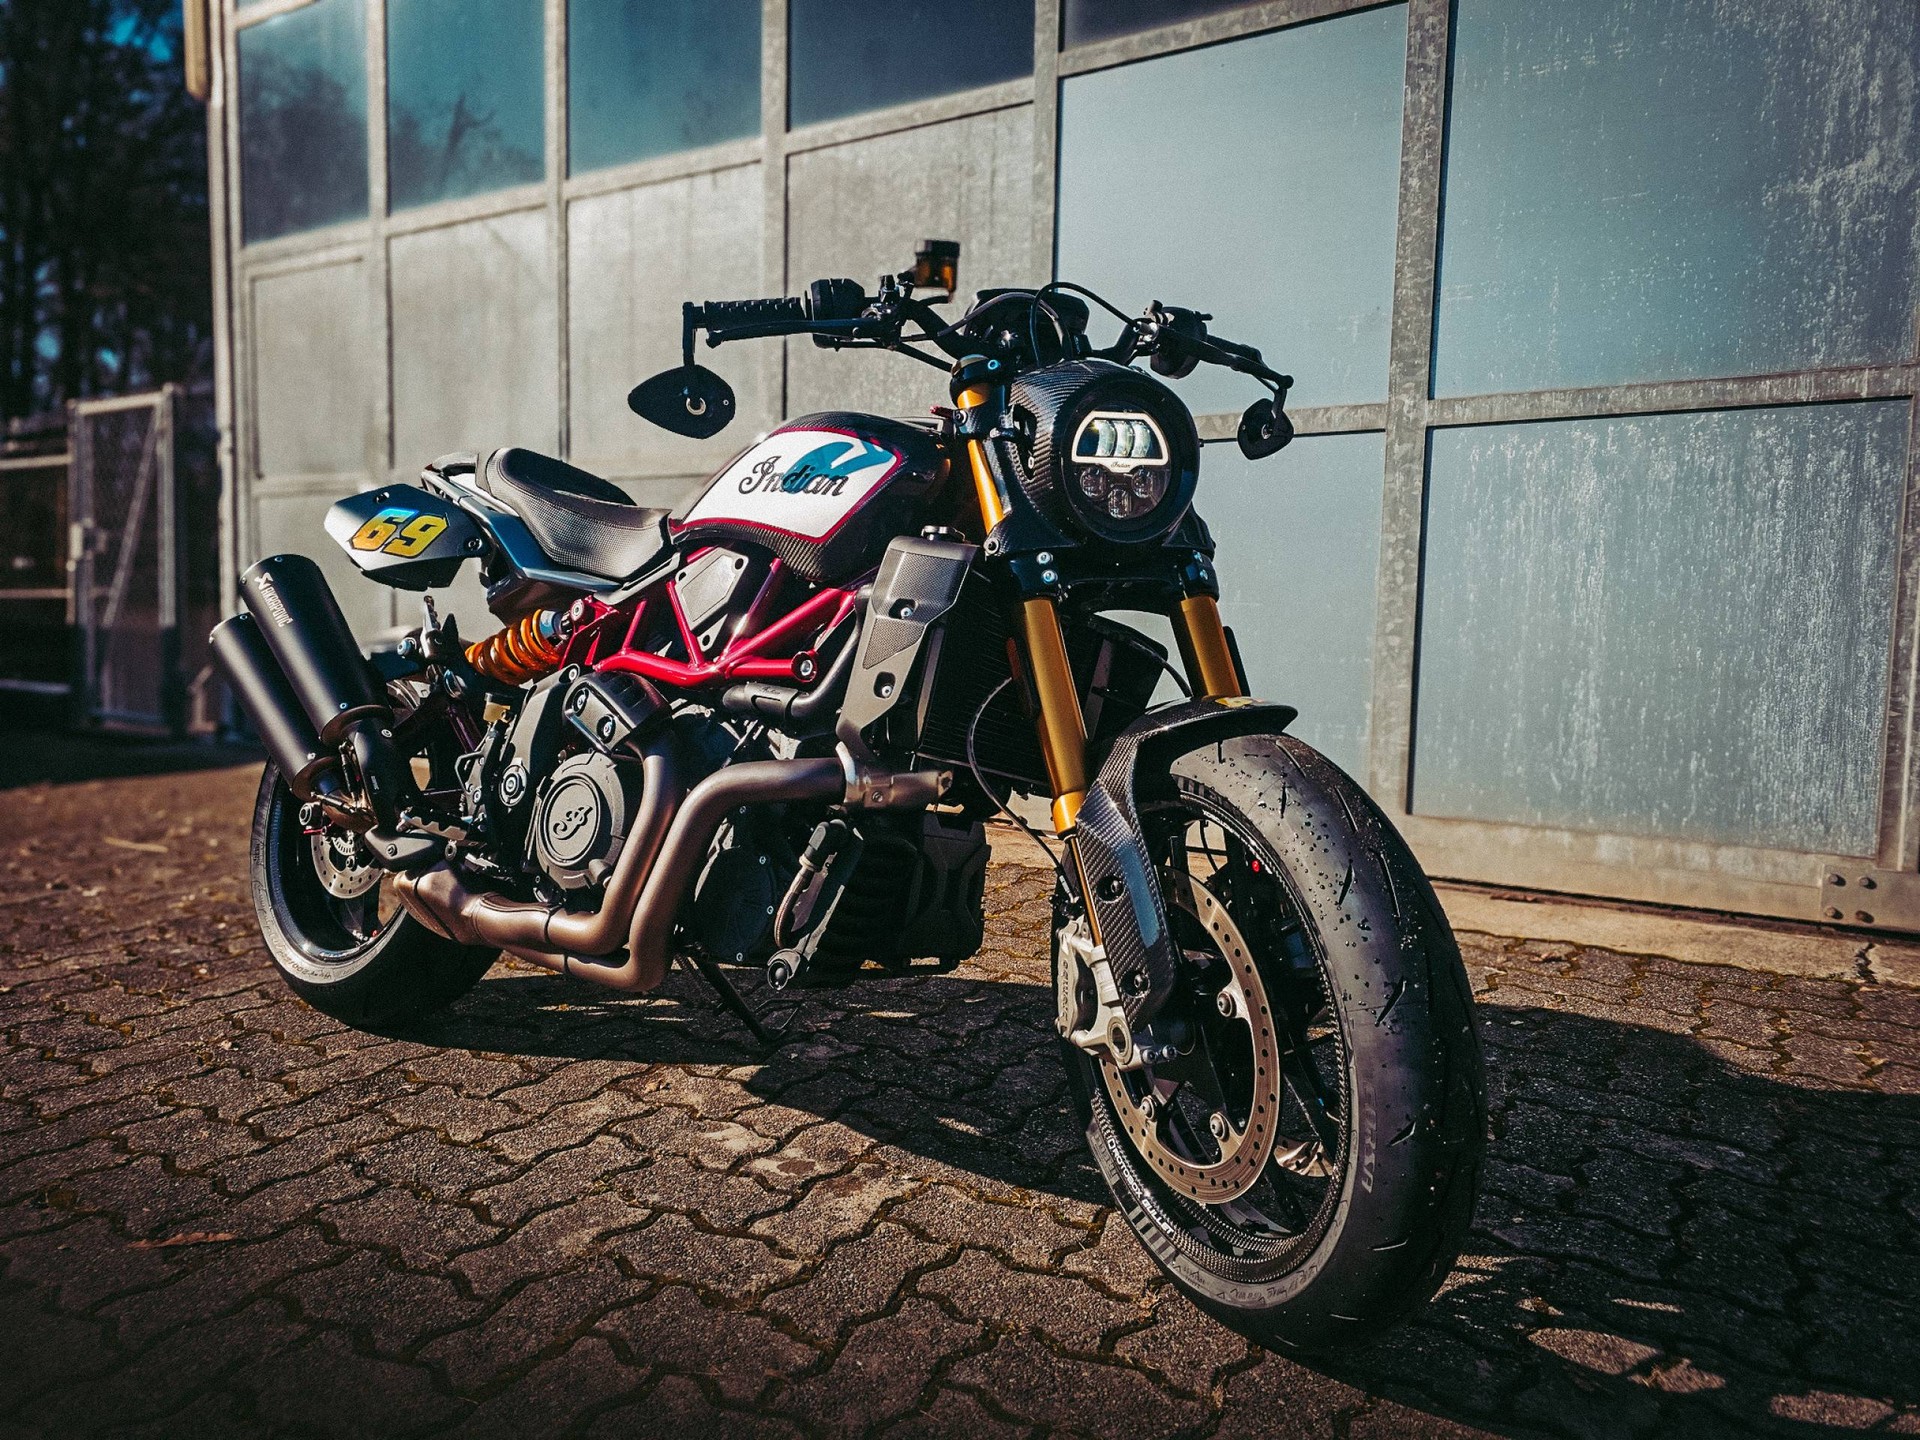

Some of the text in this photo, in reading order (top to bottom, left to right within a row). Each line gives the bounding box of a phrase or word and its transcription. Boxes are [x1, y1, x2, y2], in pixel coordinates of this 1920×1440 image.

[738, 455, 849, 497] Indian
[348, 507, 449, 559] 69
[1111, 1147, 1143, 1198] ROTOBOX
